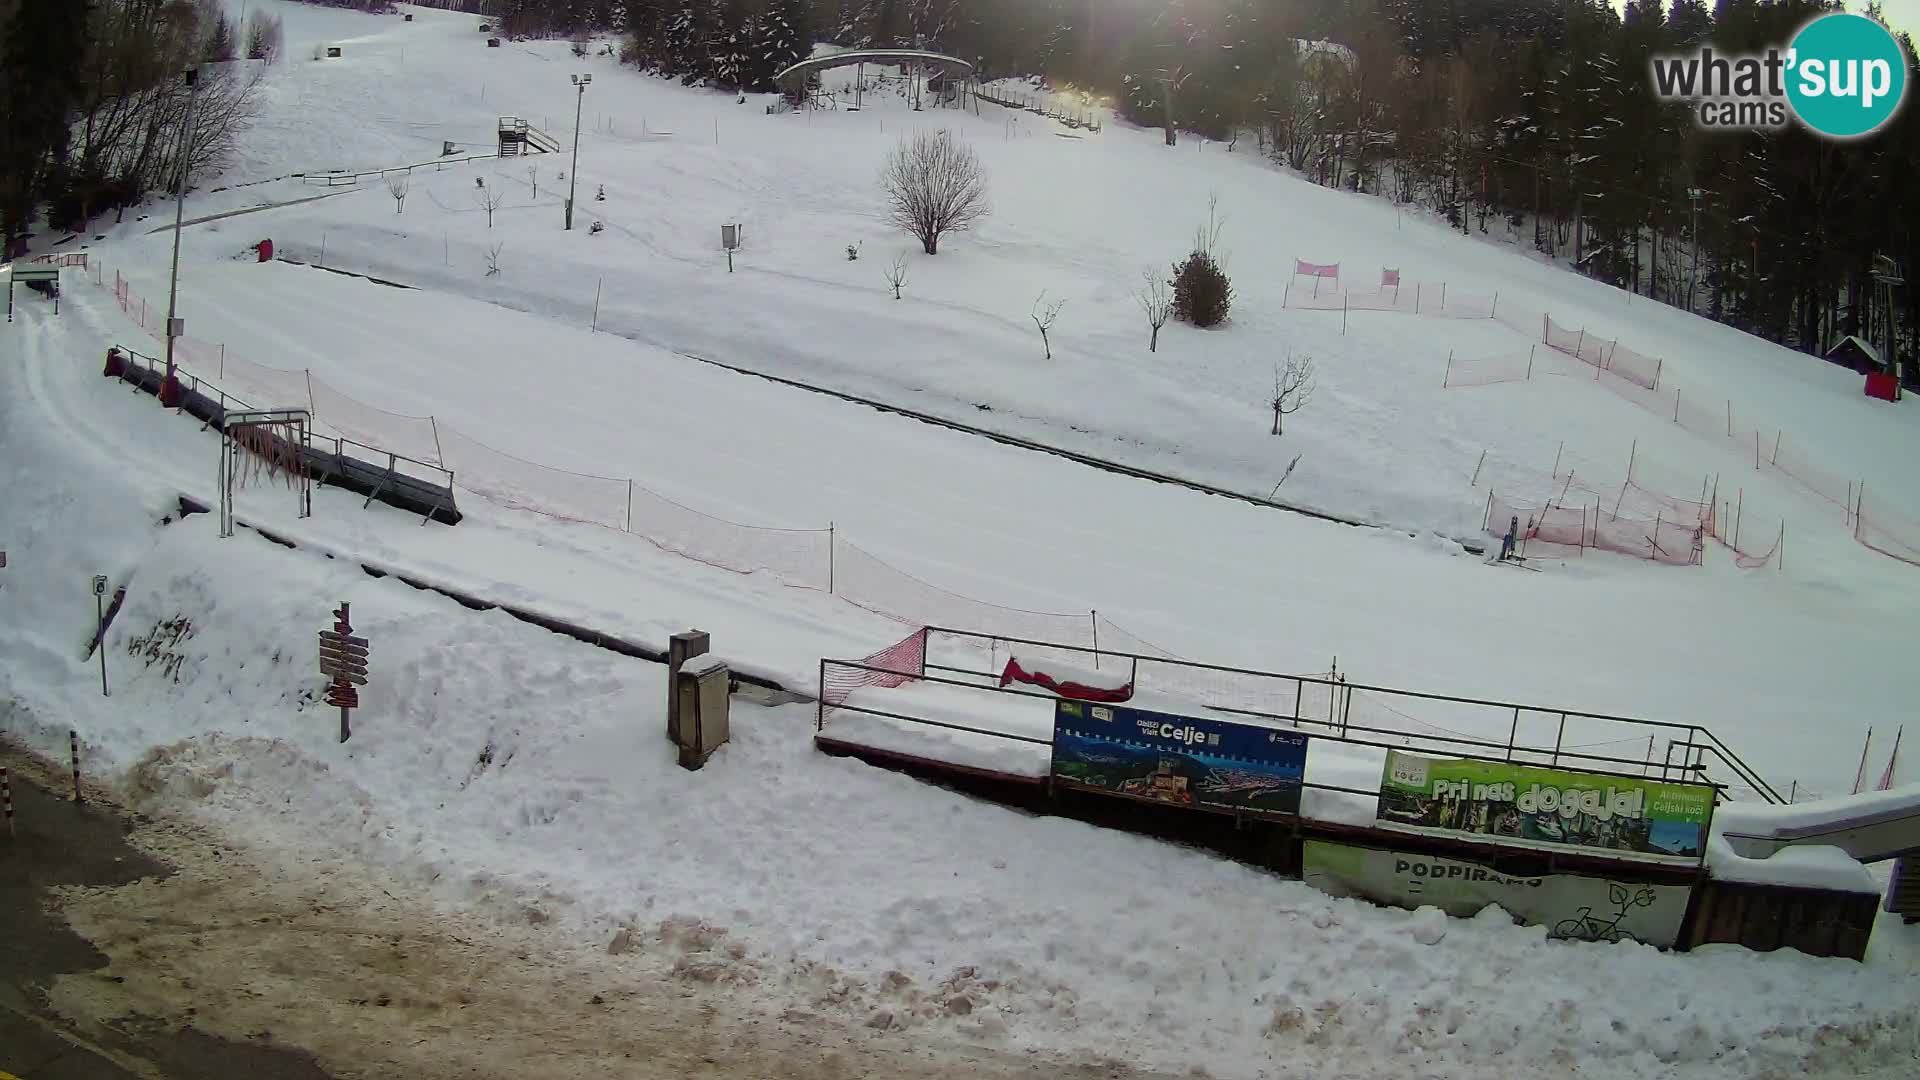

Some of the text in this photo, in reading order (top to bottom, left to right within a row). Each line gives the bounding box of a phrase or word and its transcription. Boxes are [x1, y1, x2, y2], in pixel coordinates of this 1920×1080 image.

[1160, 723, 1206, 745] Celje
[1432, 779, 1470, 801] Pri
[1474, 782, 1515, 803] nas
[1516, 783, 1645, 822] dogaja!
